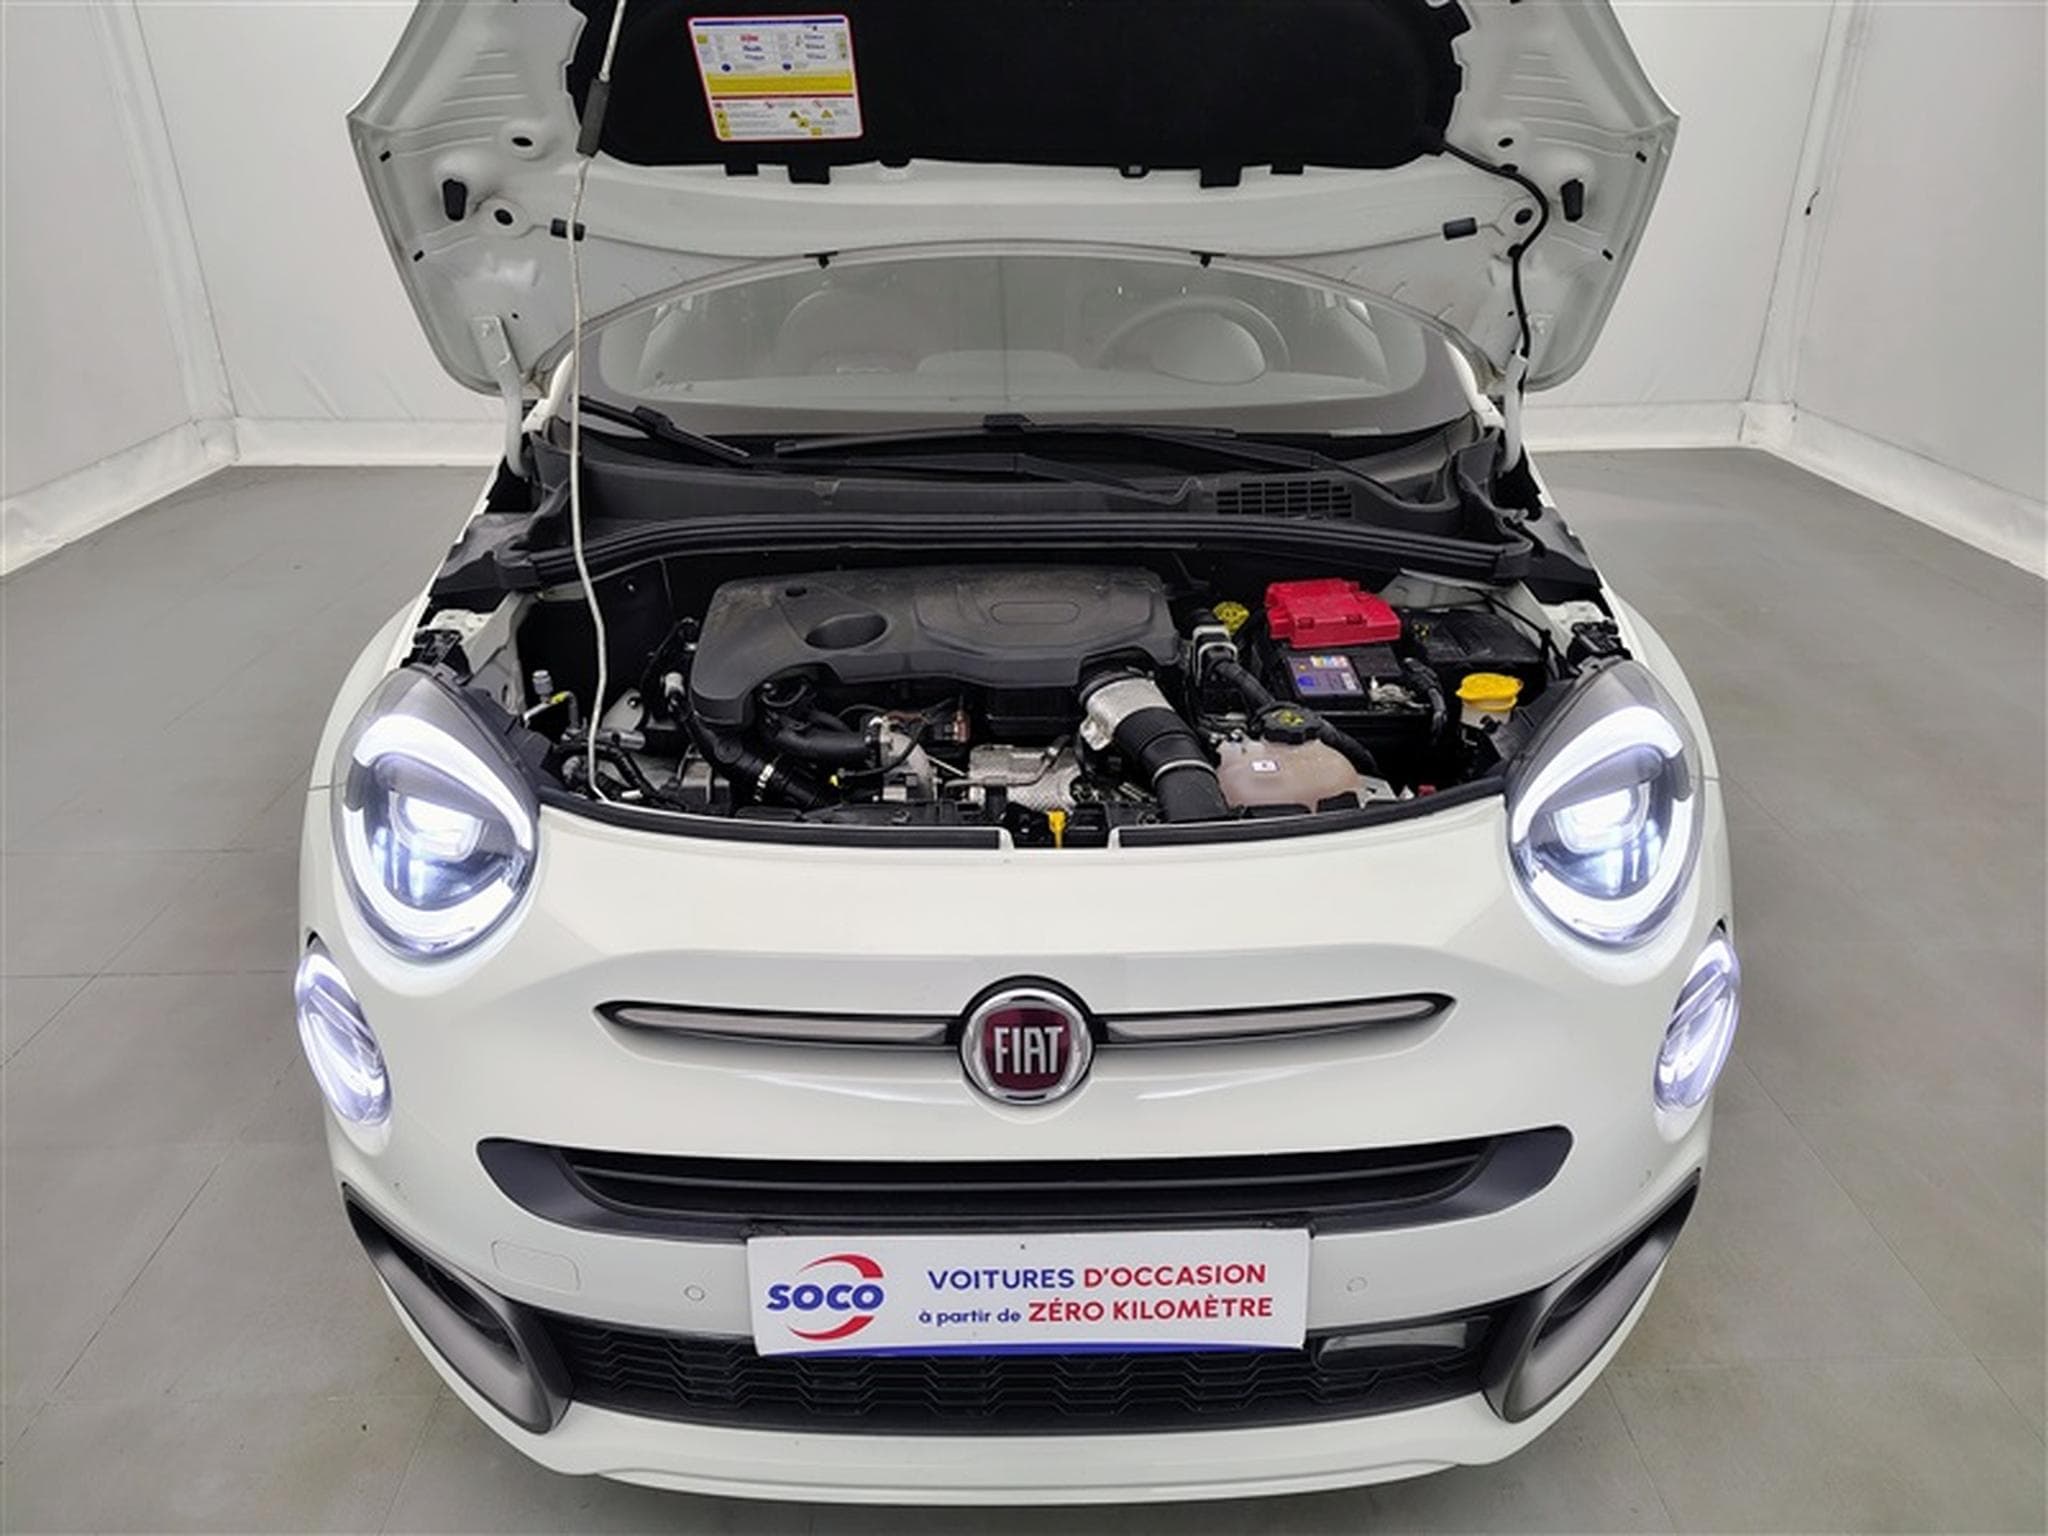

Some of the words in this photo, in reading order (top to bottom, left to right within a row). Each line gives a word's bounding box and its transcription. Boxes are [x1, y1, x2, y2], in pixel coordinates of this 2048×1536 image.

[994, 1026, 1064, 1075] FIAT
[928, 1268, 1074, 1290] VOITURES
[1084, 1264, 1267, 1287] D'OCCASION
[766, 1283, 885, 1311] SOCO
[919, 1308, 932, 1324] à
[937, 1305, 991, 1328] partir
[997, 1304, 1021, 1323] de
[1028, 1296, 1105, 1323] ZÉRO
[1113, 1294, 1273, 1320] KILOMÈTRE
